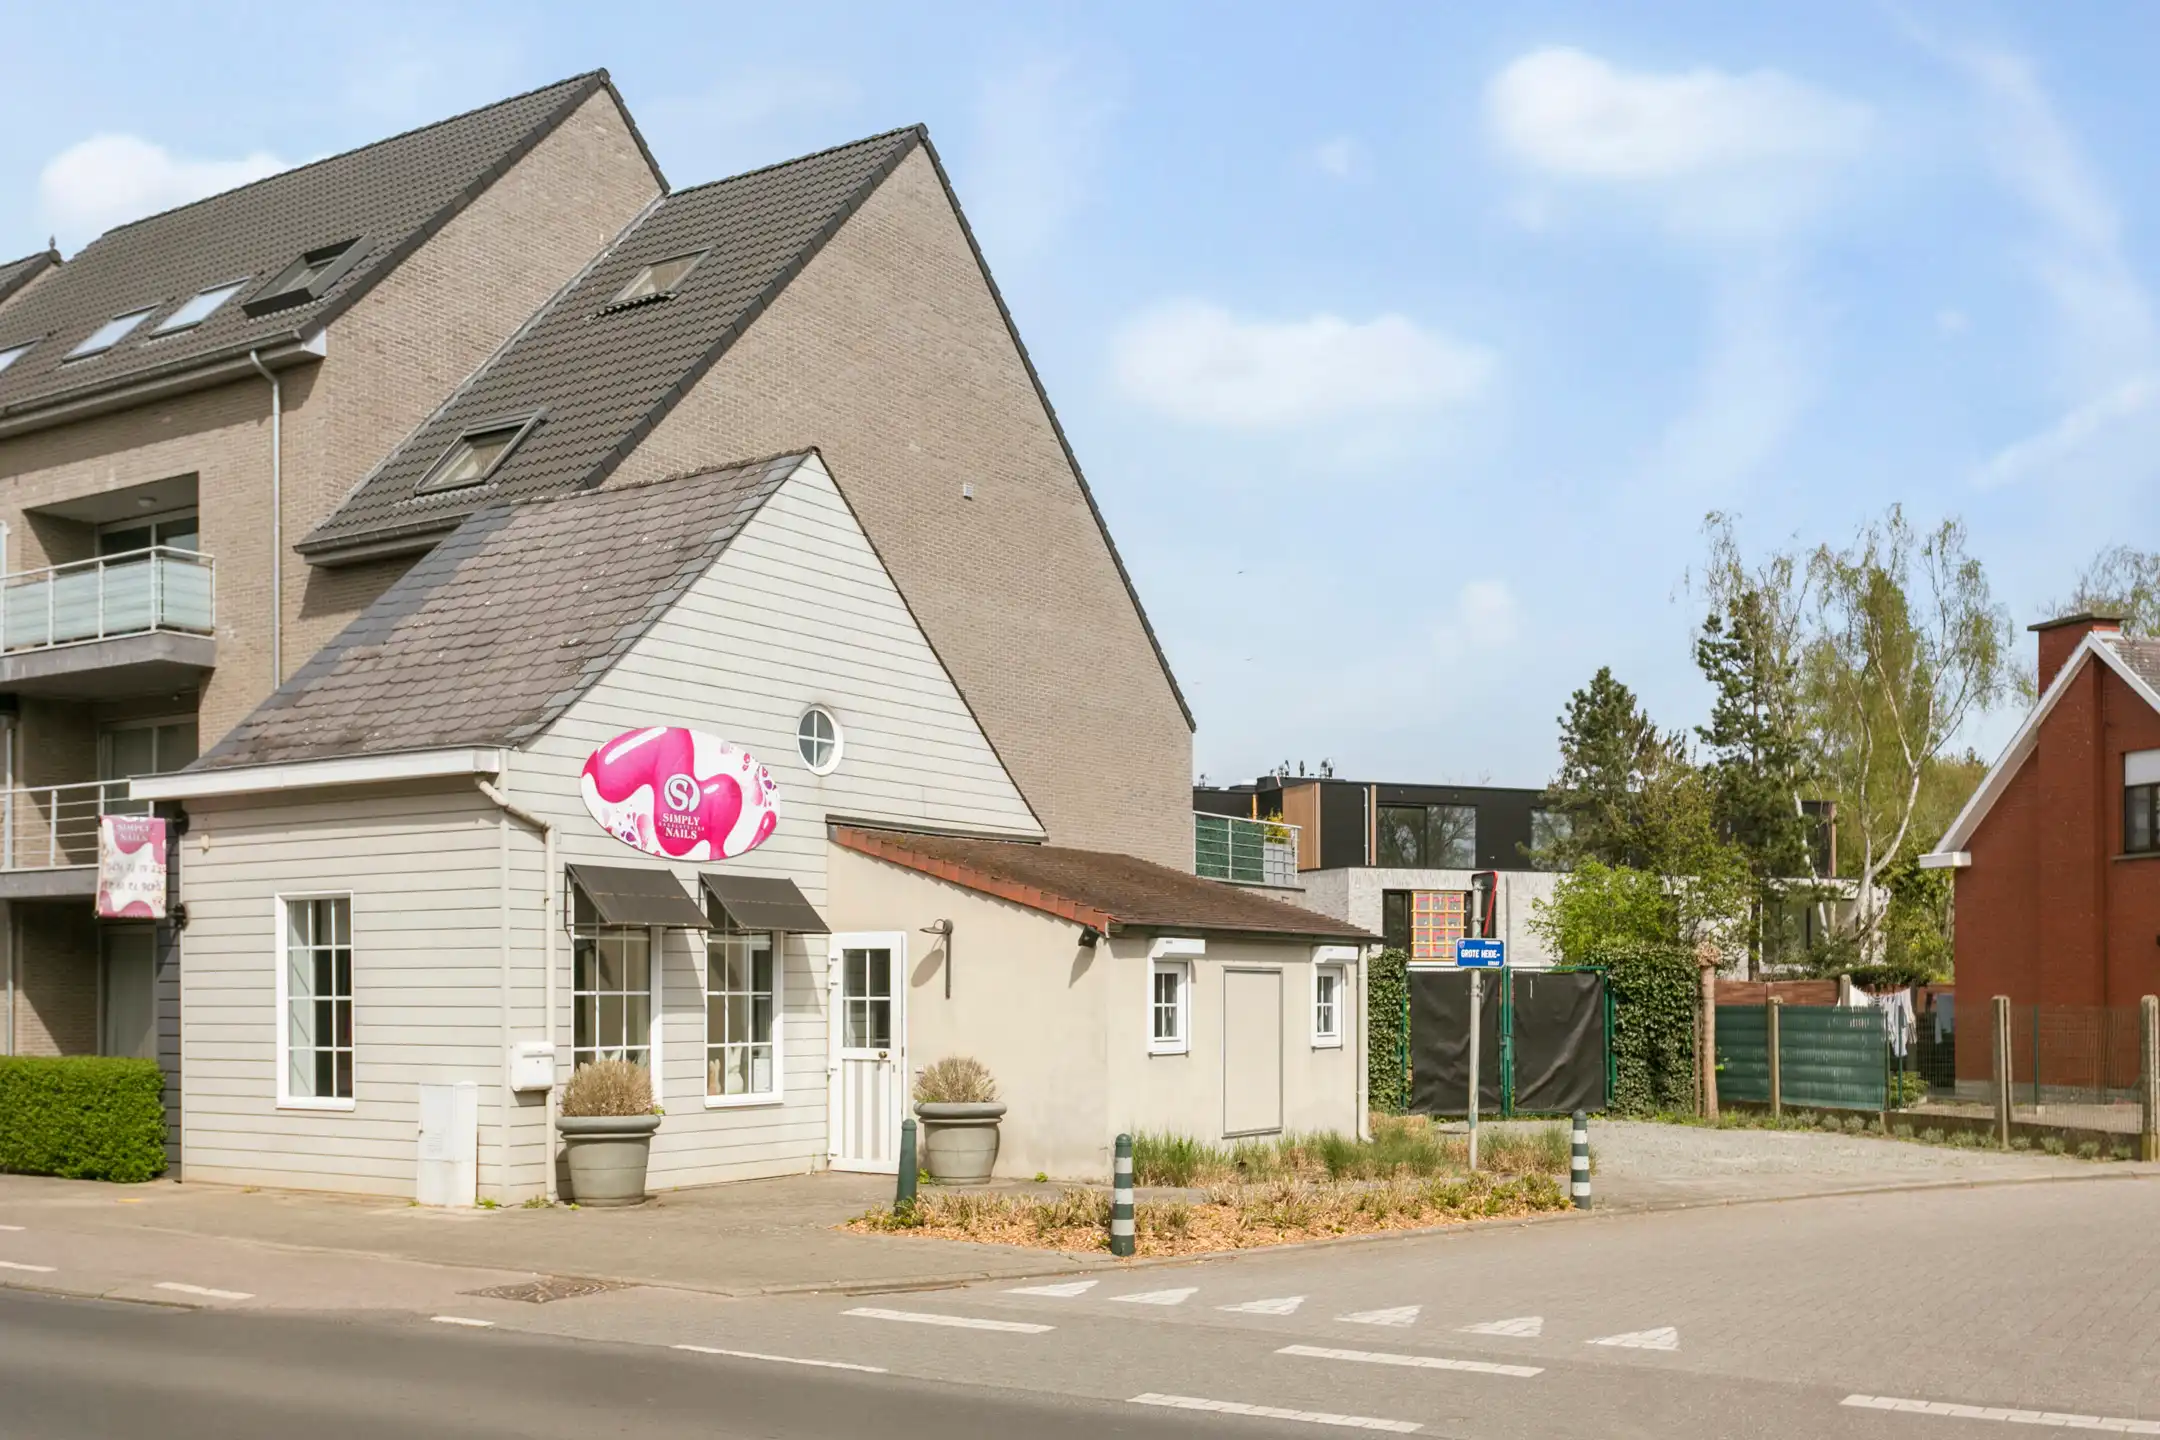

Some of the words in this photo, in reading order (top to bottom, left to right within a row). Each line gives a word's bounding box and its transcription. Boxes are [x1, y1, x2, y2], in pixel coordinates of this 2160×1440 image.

[662, 812, 700, 826] SIMPLY
[665, 827, 698, 840] NAILS
[1461, 949, 1480, 959] GROTE
